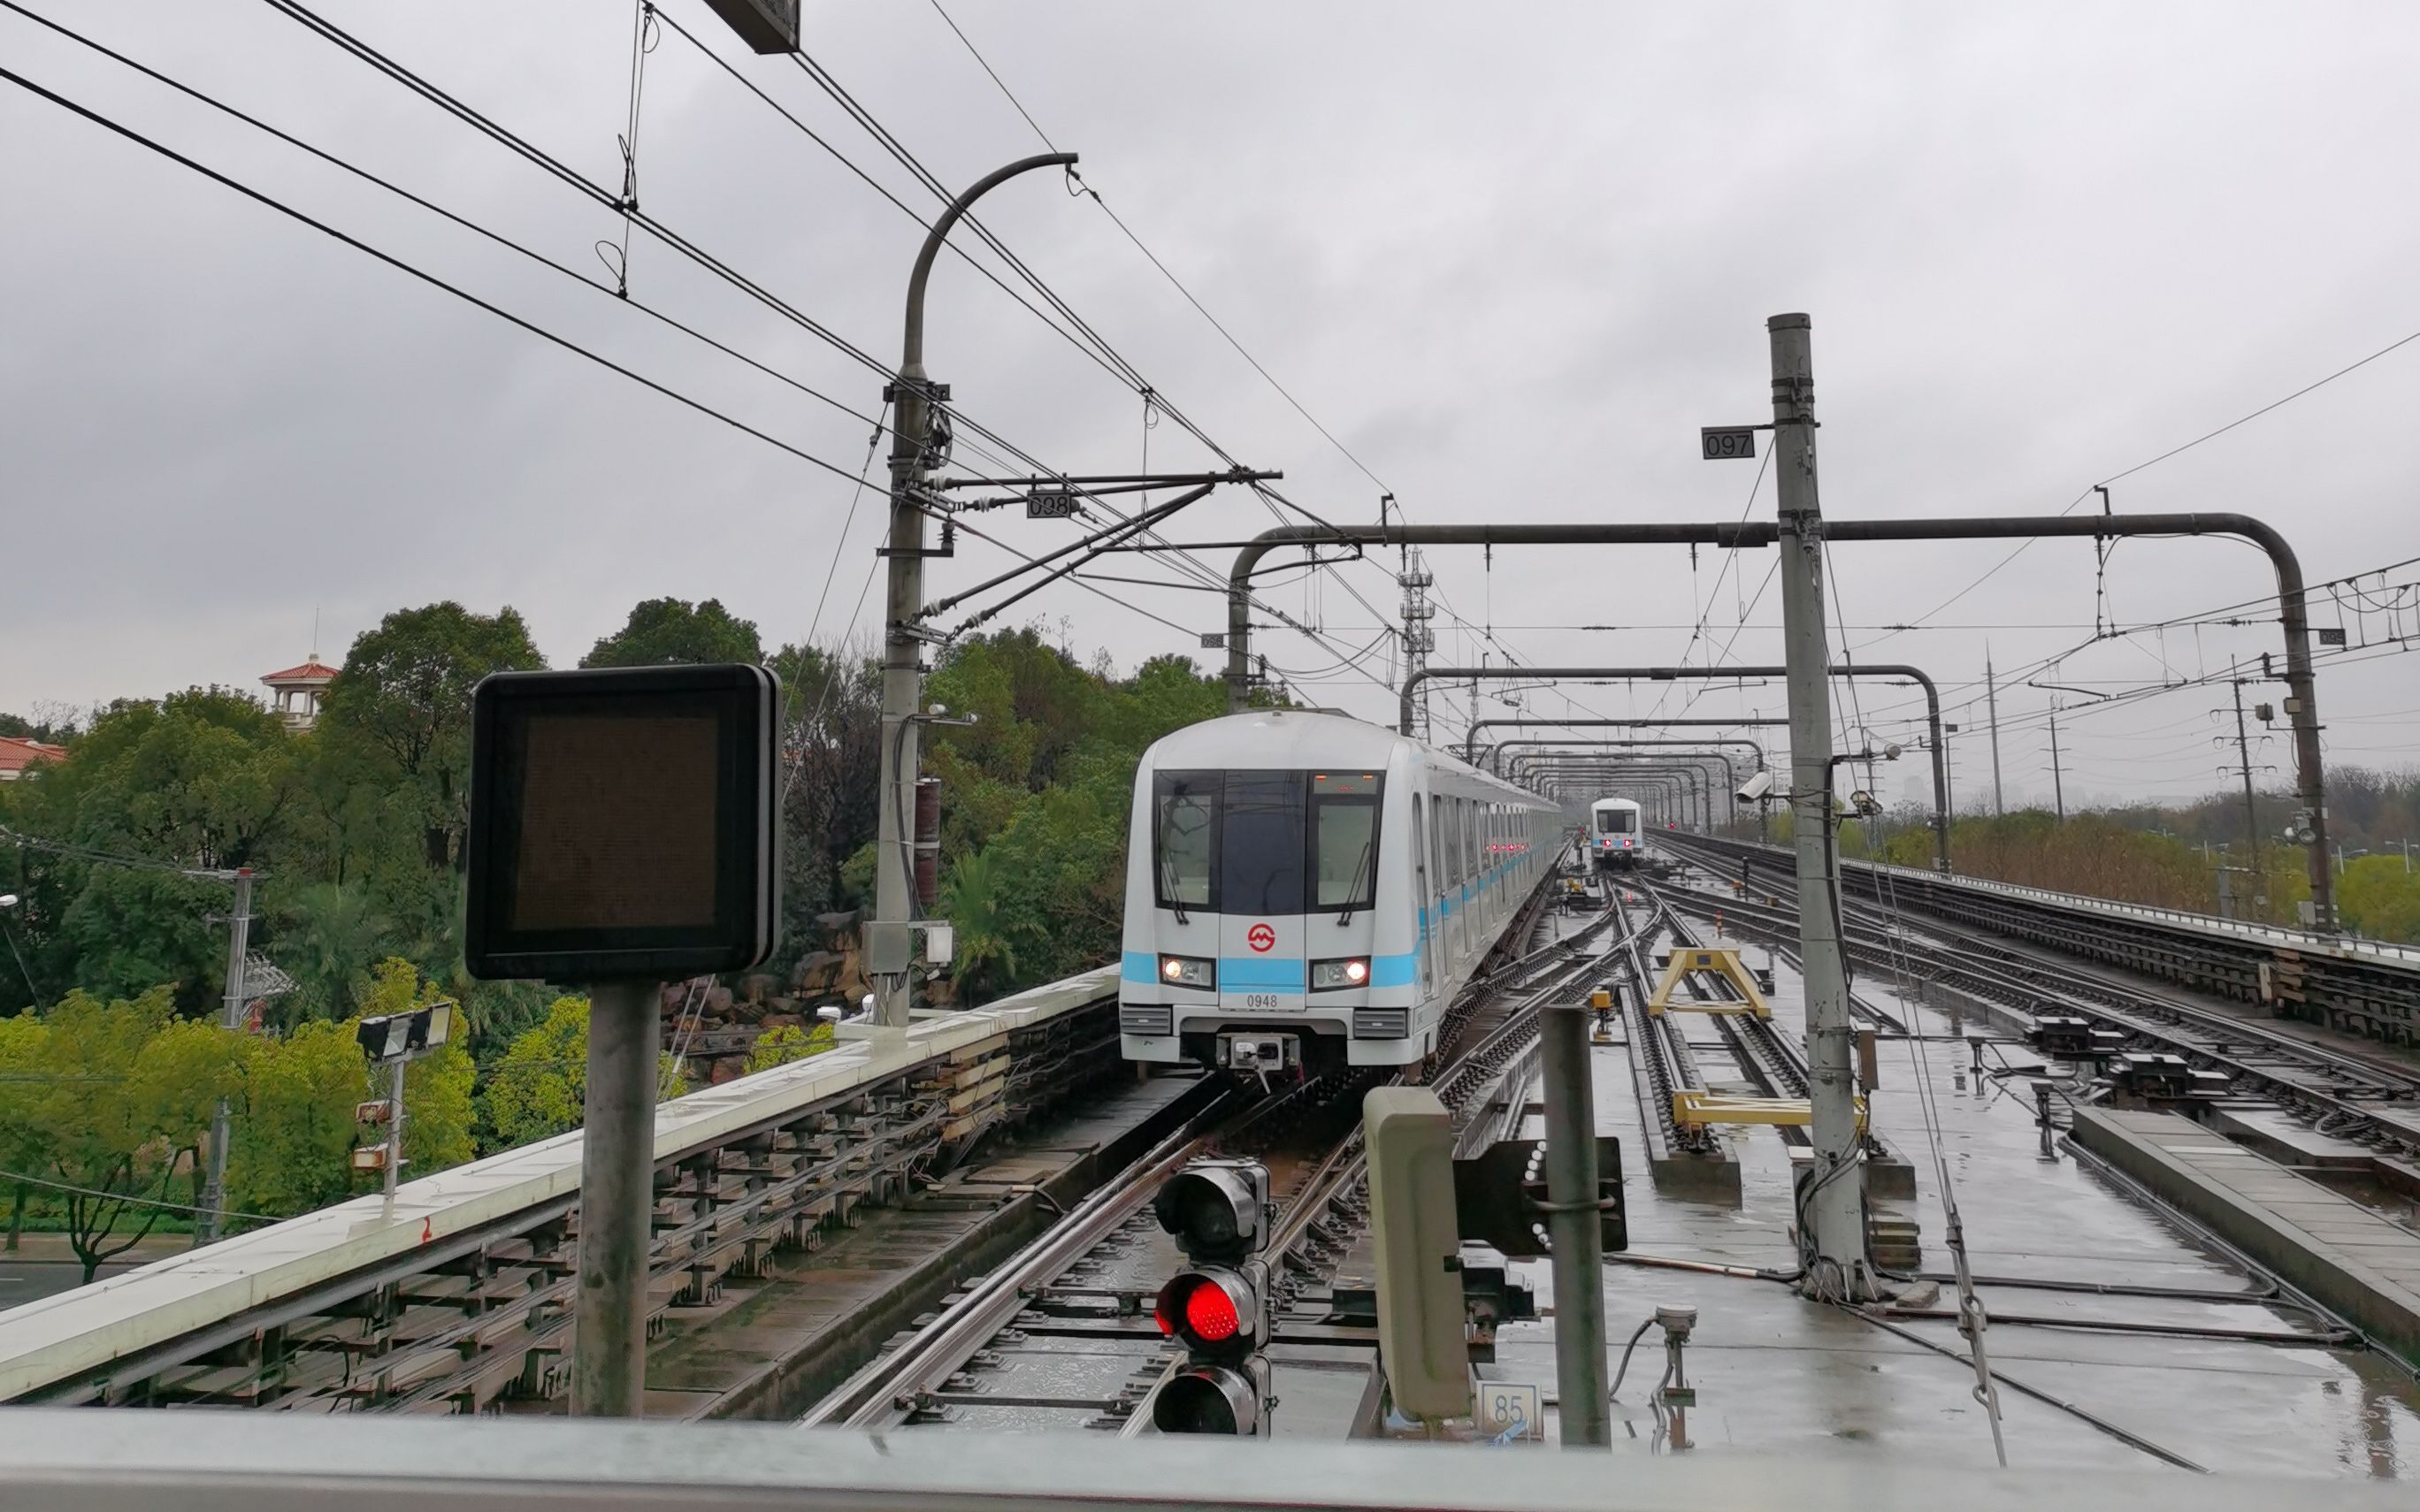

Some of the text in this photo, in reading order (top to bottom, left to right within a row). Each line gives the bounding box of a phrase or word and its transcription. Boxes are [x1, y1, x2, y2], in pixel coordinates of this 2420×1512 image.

[1706, 435, 1750, 455] 097
[1030, 496, 1068, 515] 098
[1247, 994, 1277, 1008] 0948
[1495, 1394, 1523, 1424] 85
